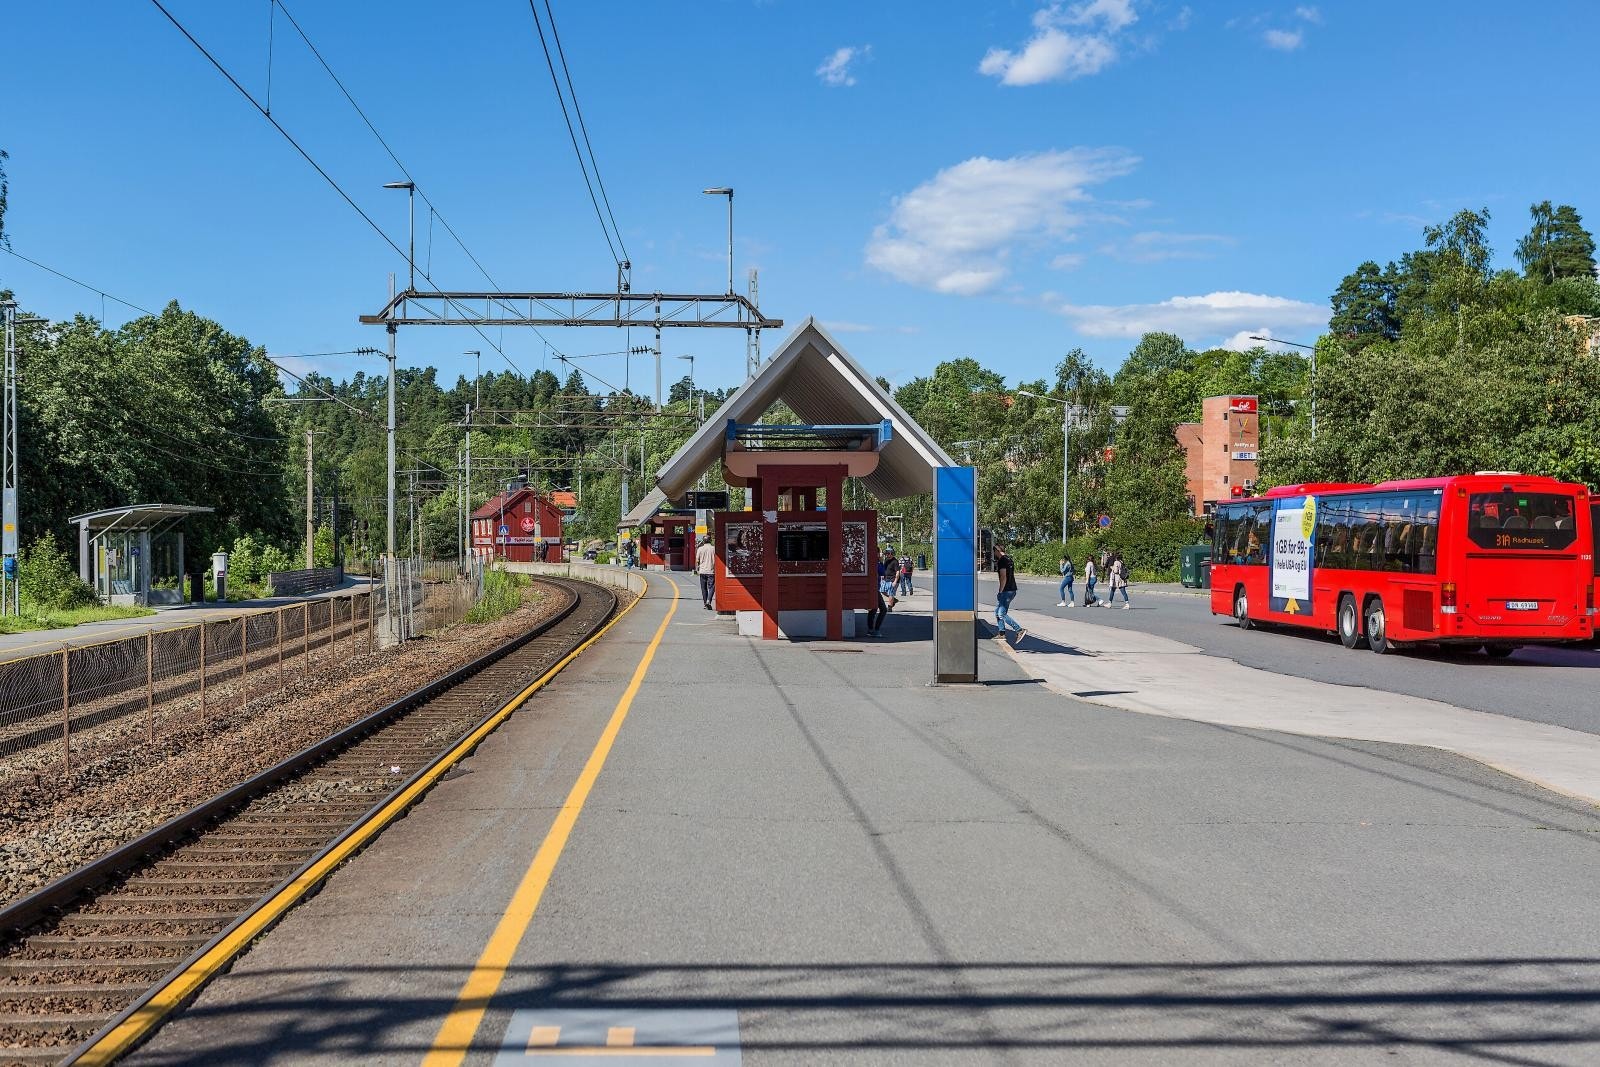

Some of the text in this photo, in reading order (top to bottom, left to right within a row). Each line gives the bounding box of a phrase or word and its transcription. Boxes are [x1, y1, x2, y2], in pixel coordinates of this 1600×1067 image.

[1276, 540, 1287, 554] 1GB
[1286, 560, 1294, 570] USA
[1295, 562, 1300, 572] og
[1301, 560, 1306, 570] EU
